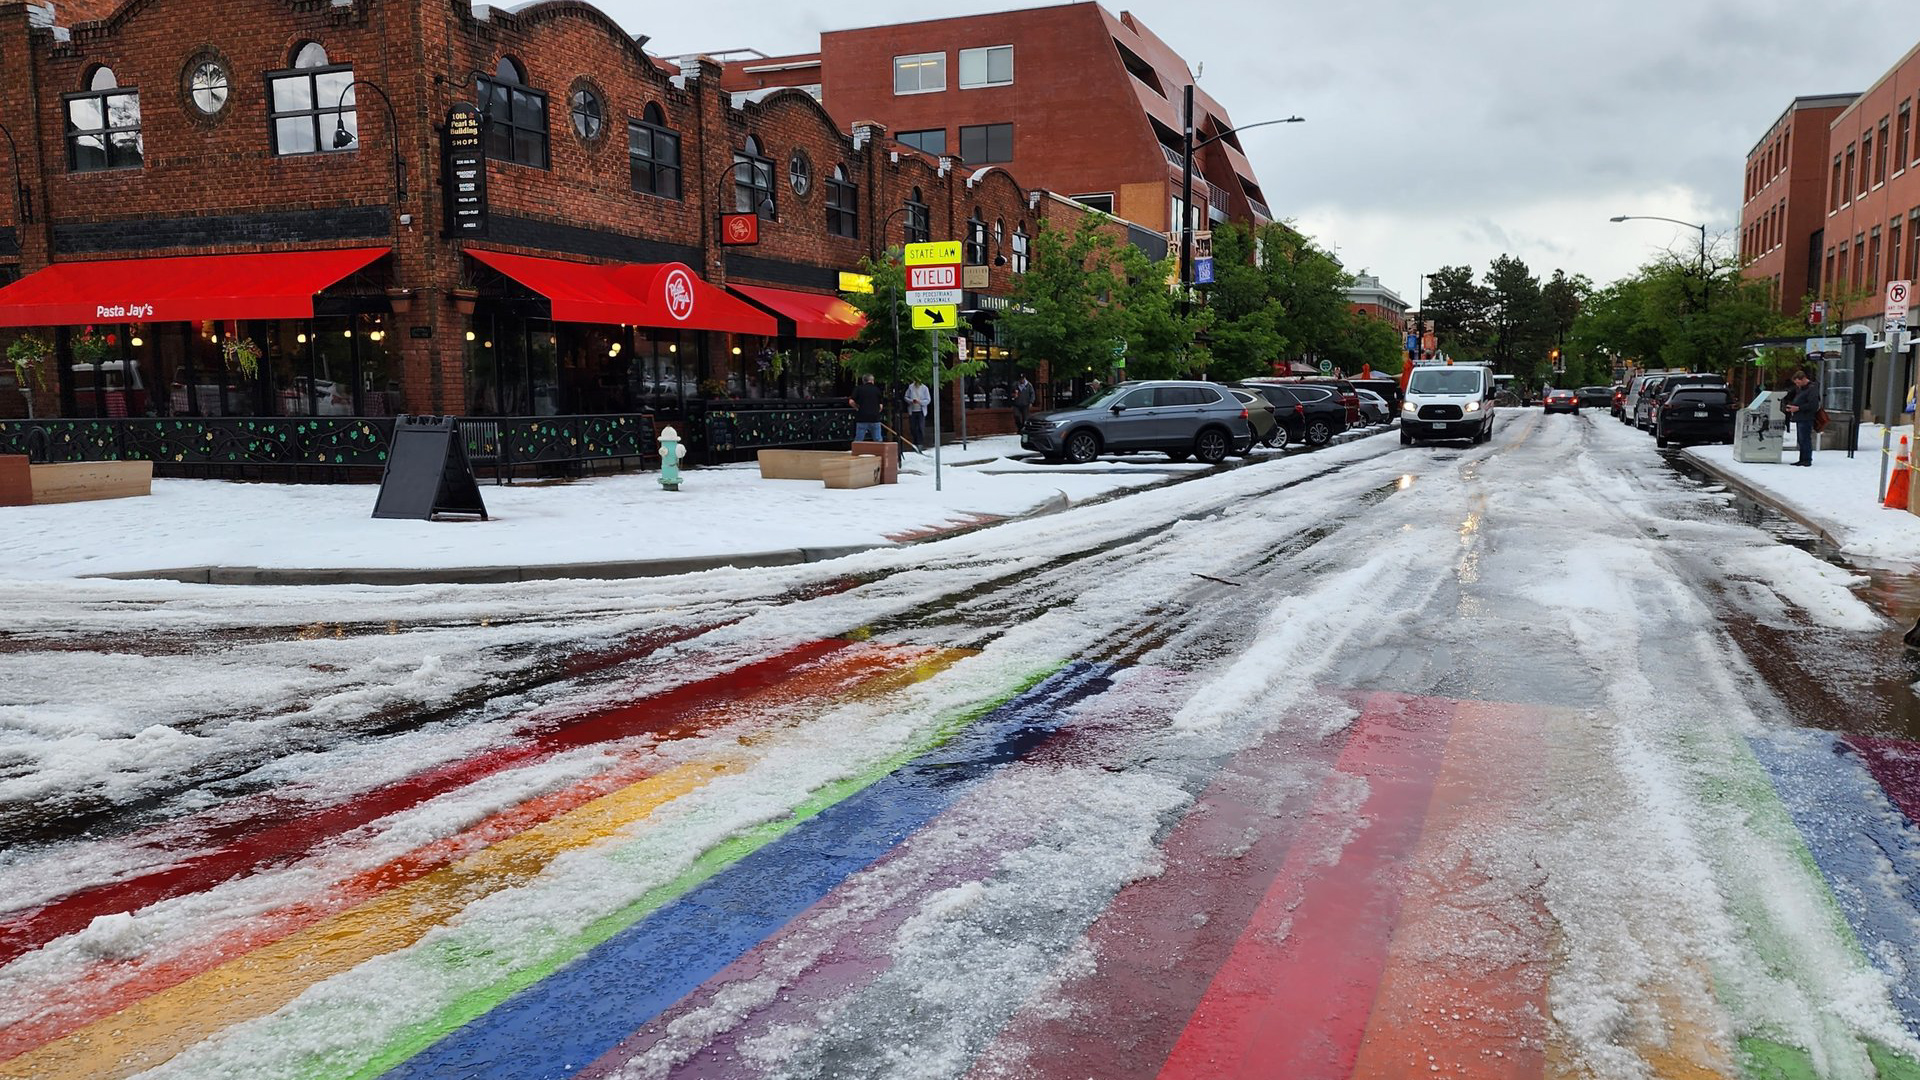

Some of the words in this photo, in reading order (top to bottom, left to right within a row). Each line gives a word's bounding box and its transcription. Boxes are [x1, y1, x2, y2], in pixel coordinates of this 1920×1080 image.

[910, 249, 934, 259] STATE
[940, 248, 956, 258] LAW
[914, 269, 953, 285] YIELD
[96, 305, 124, 318] Pasta
[126, 304, 152, 318] Jay's
